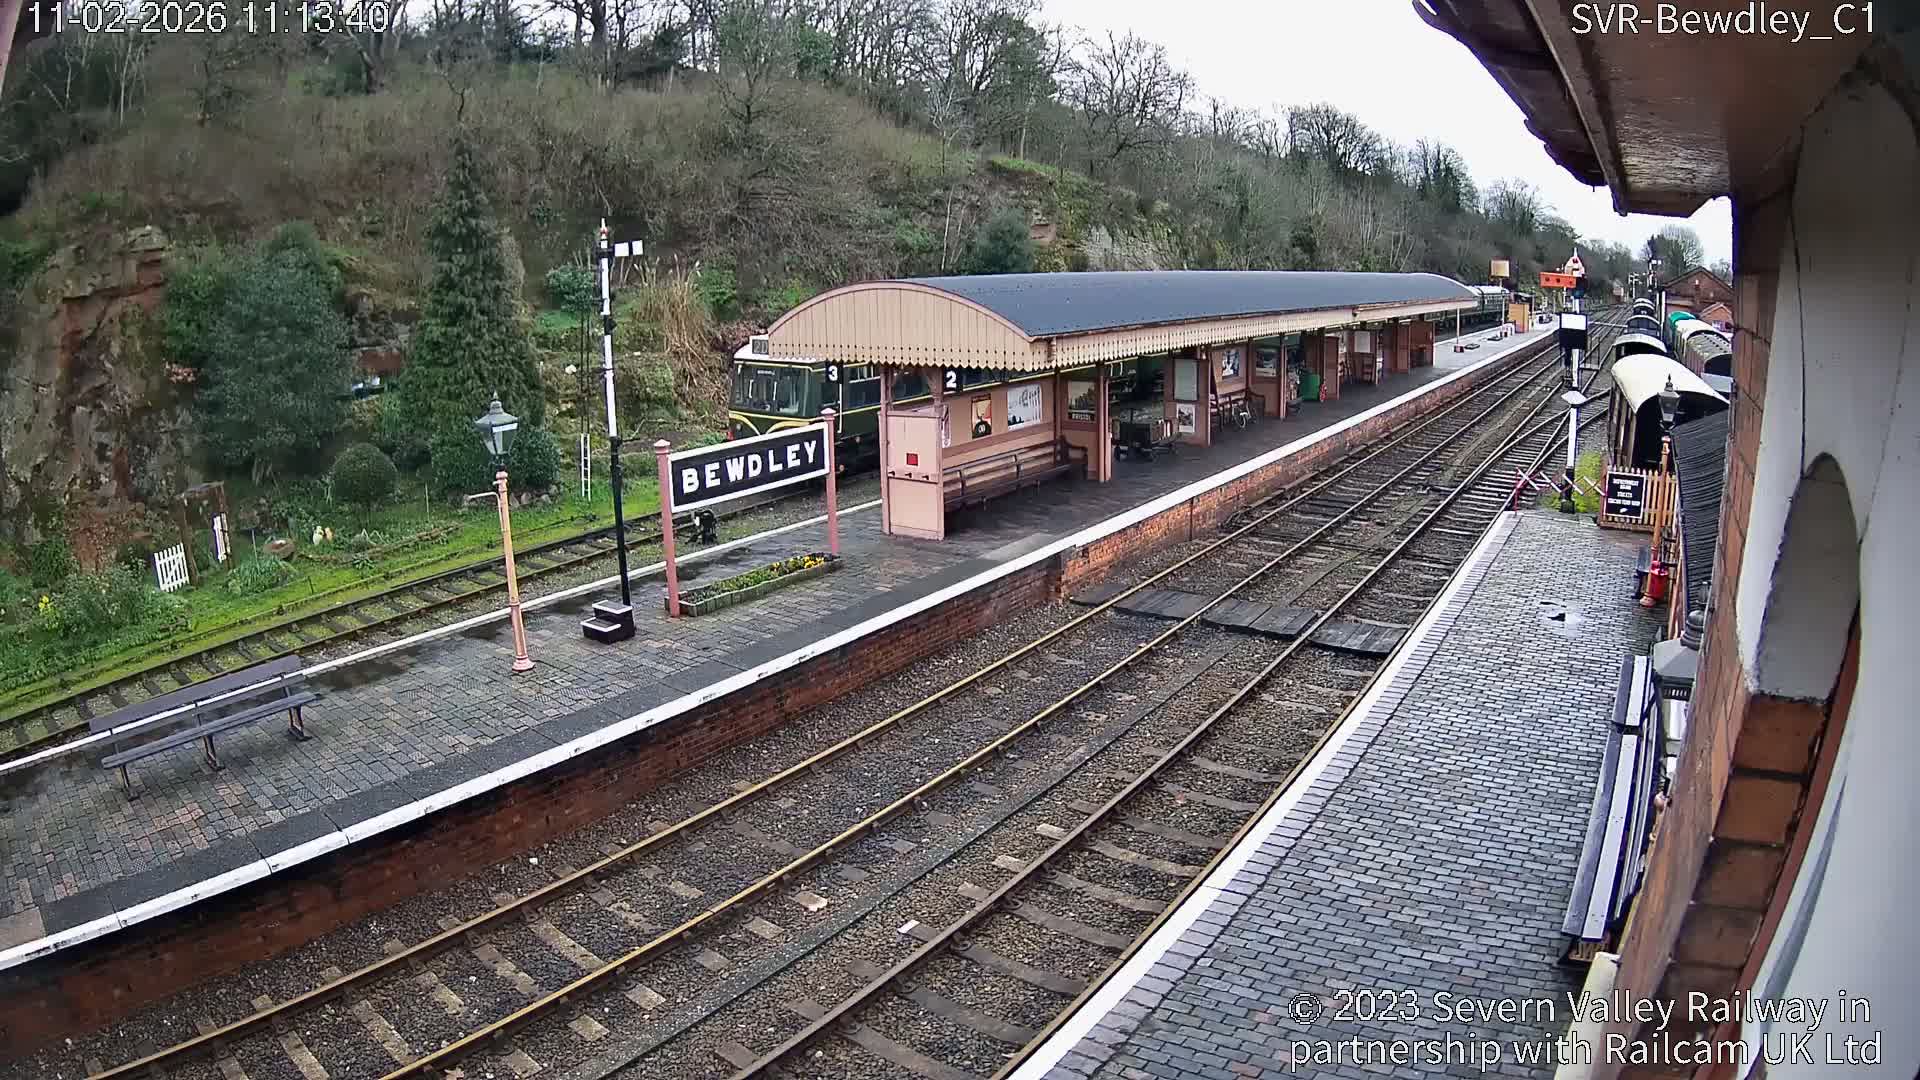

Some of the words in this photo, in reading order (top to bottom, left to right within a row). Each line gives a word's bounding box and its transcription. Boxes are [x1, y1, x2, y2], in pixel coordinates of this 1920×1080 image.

[828, 365, 838, 382] 3
[945, 370, 958, 389] 2
[681, 440, 817, 495] BEWDLEY
